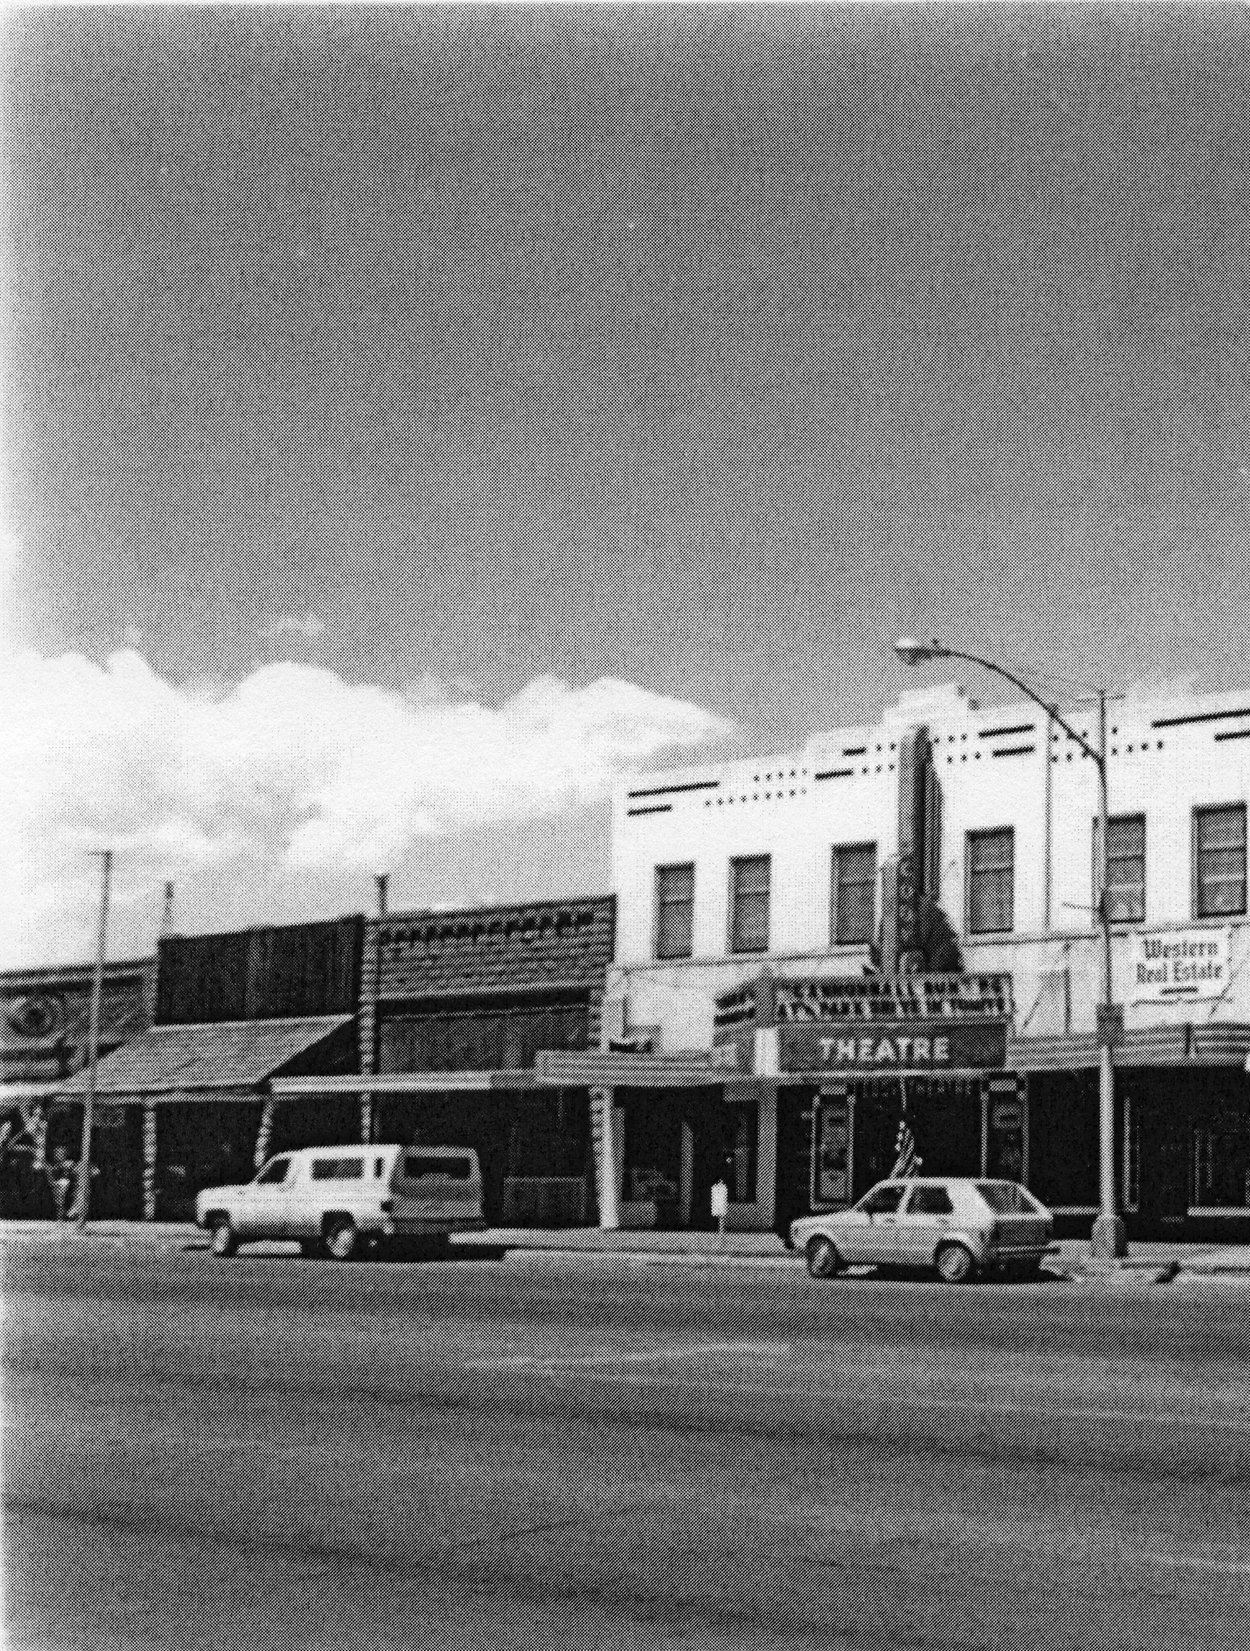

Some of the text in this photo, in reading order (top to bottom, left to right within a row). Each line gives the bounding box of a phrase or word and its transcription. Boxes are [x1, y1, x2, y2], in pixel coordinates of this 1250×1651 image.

[1142, 938, 1219, 960] Western
[1136, 960, 1223, 985] Real Estate
[821, 1037, 950, 1061] THEATRE
